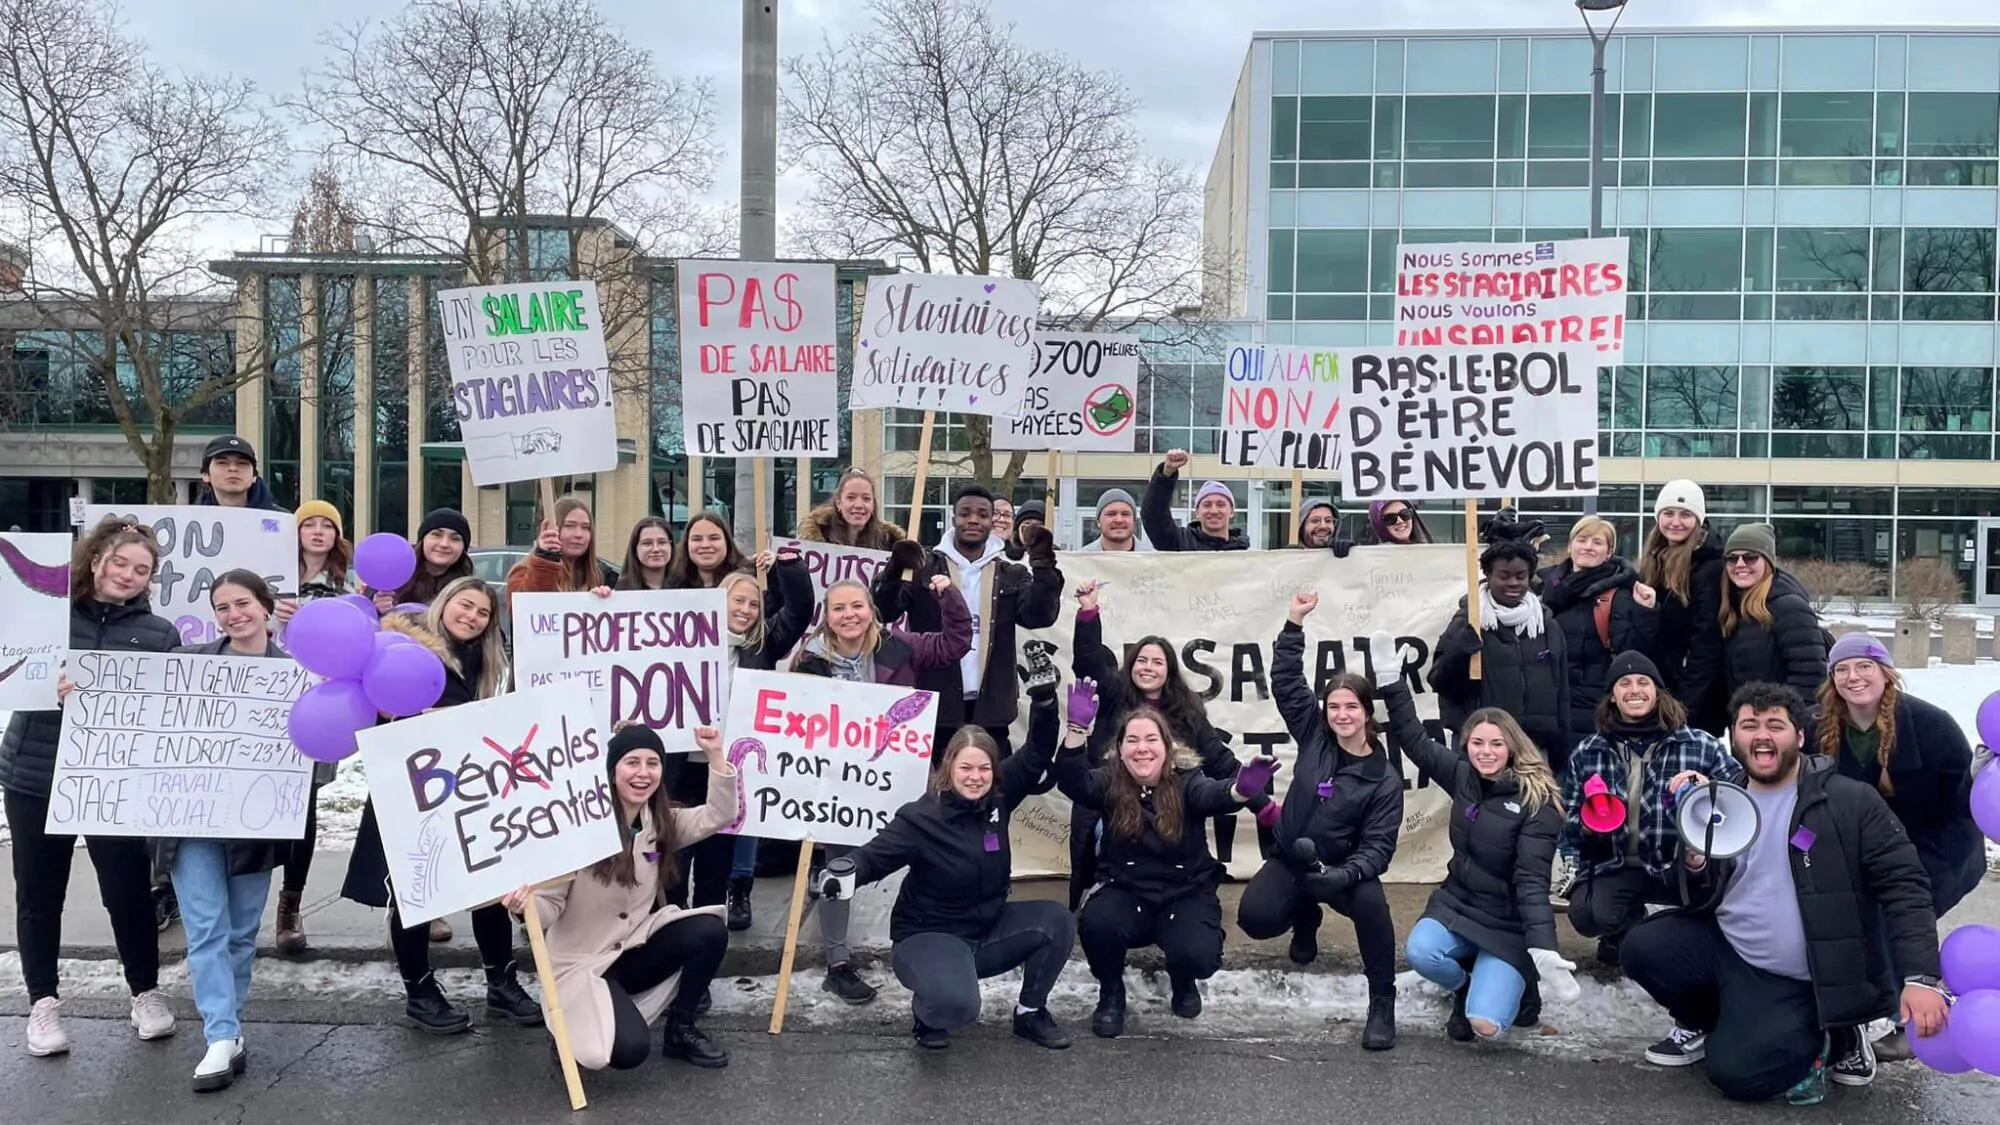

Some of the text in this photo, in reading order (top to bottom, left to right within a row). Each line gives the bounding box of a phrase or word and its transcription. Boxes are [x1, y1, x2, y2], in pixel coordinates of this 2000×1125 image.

[1397, 272, 1440, 297] LES
[438, 296, 476, 340] UN
[875, 281, 1035, 348] Stagiaires
[461, 337, 580, 371] POUR LES
[699, 344, 737, 375] DE
[1102, 342, 1139, 357] HEURES
[1286, 352, 1311, 382] LA
[1024, 386, 1049, 411] AS
[1228, 386, 1313, 430] NON
[697, 422, 726, 455] DE
[1350, 434, 1598, 498] BÉNÉVOLE
[530, 609, 720, 659] UNE PROFESSION
[75, 652, 152, 692] STAGE
[164, 658, 194, 693] EN
[71, 691, 153, 728] STAGE
[160, 697, 192, 728] EN
[194, 698, 237, 729] INFO
[610, 660, 722, 733] DON!
[754, 689, 933, 758] Exploitées
[64, 727, 145, 767] STAGE
[153, 736, 183, 763] EN
[186, 736, 241, 766] DROIT
[842, 761, 893, 791] nos
[53, 772, 224, 826] STAGE TRAVAIL
[143, 797, 219, 829] SOCIAL
[754, 786, 889, 835] Passions
